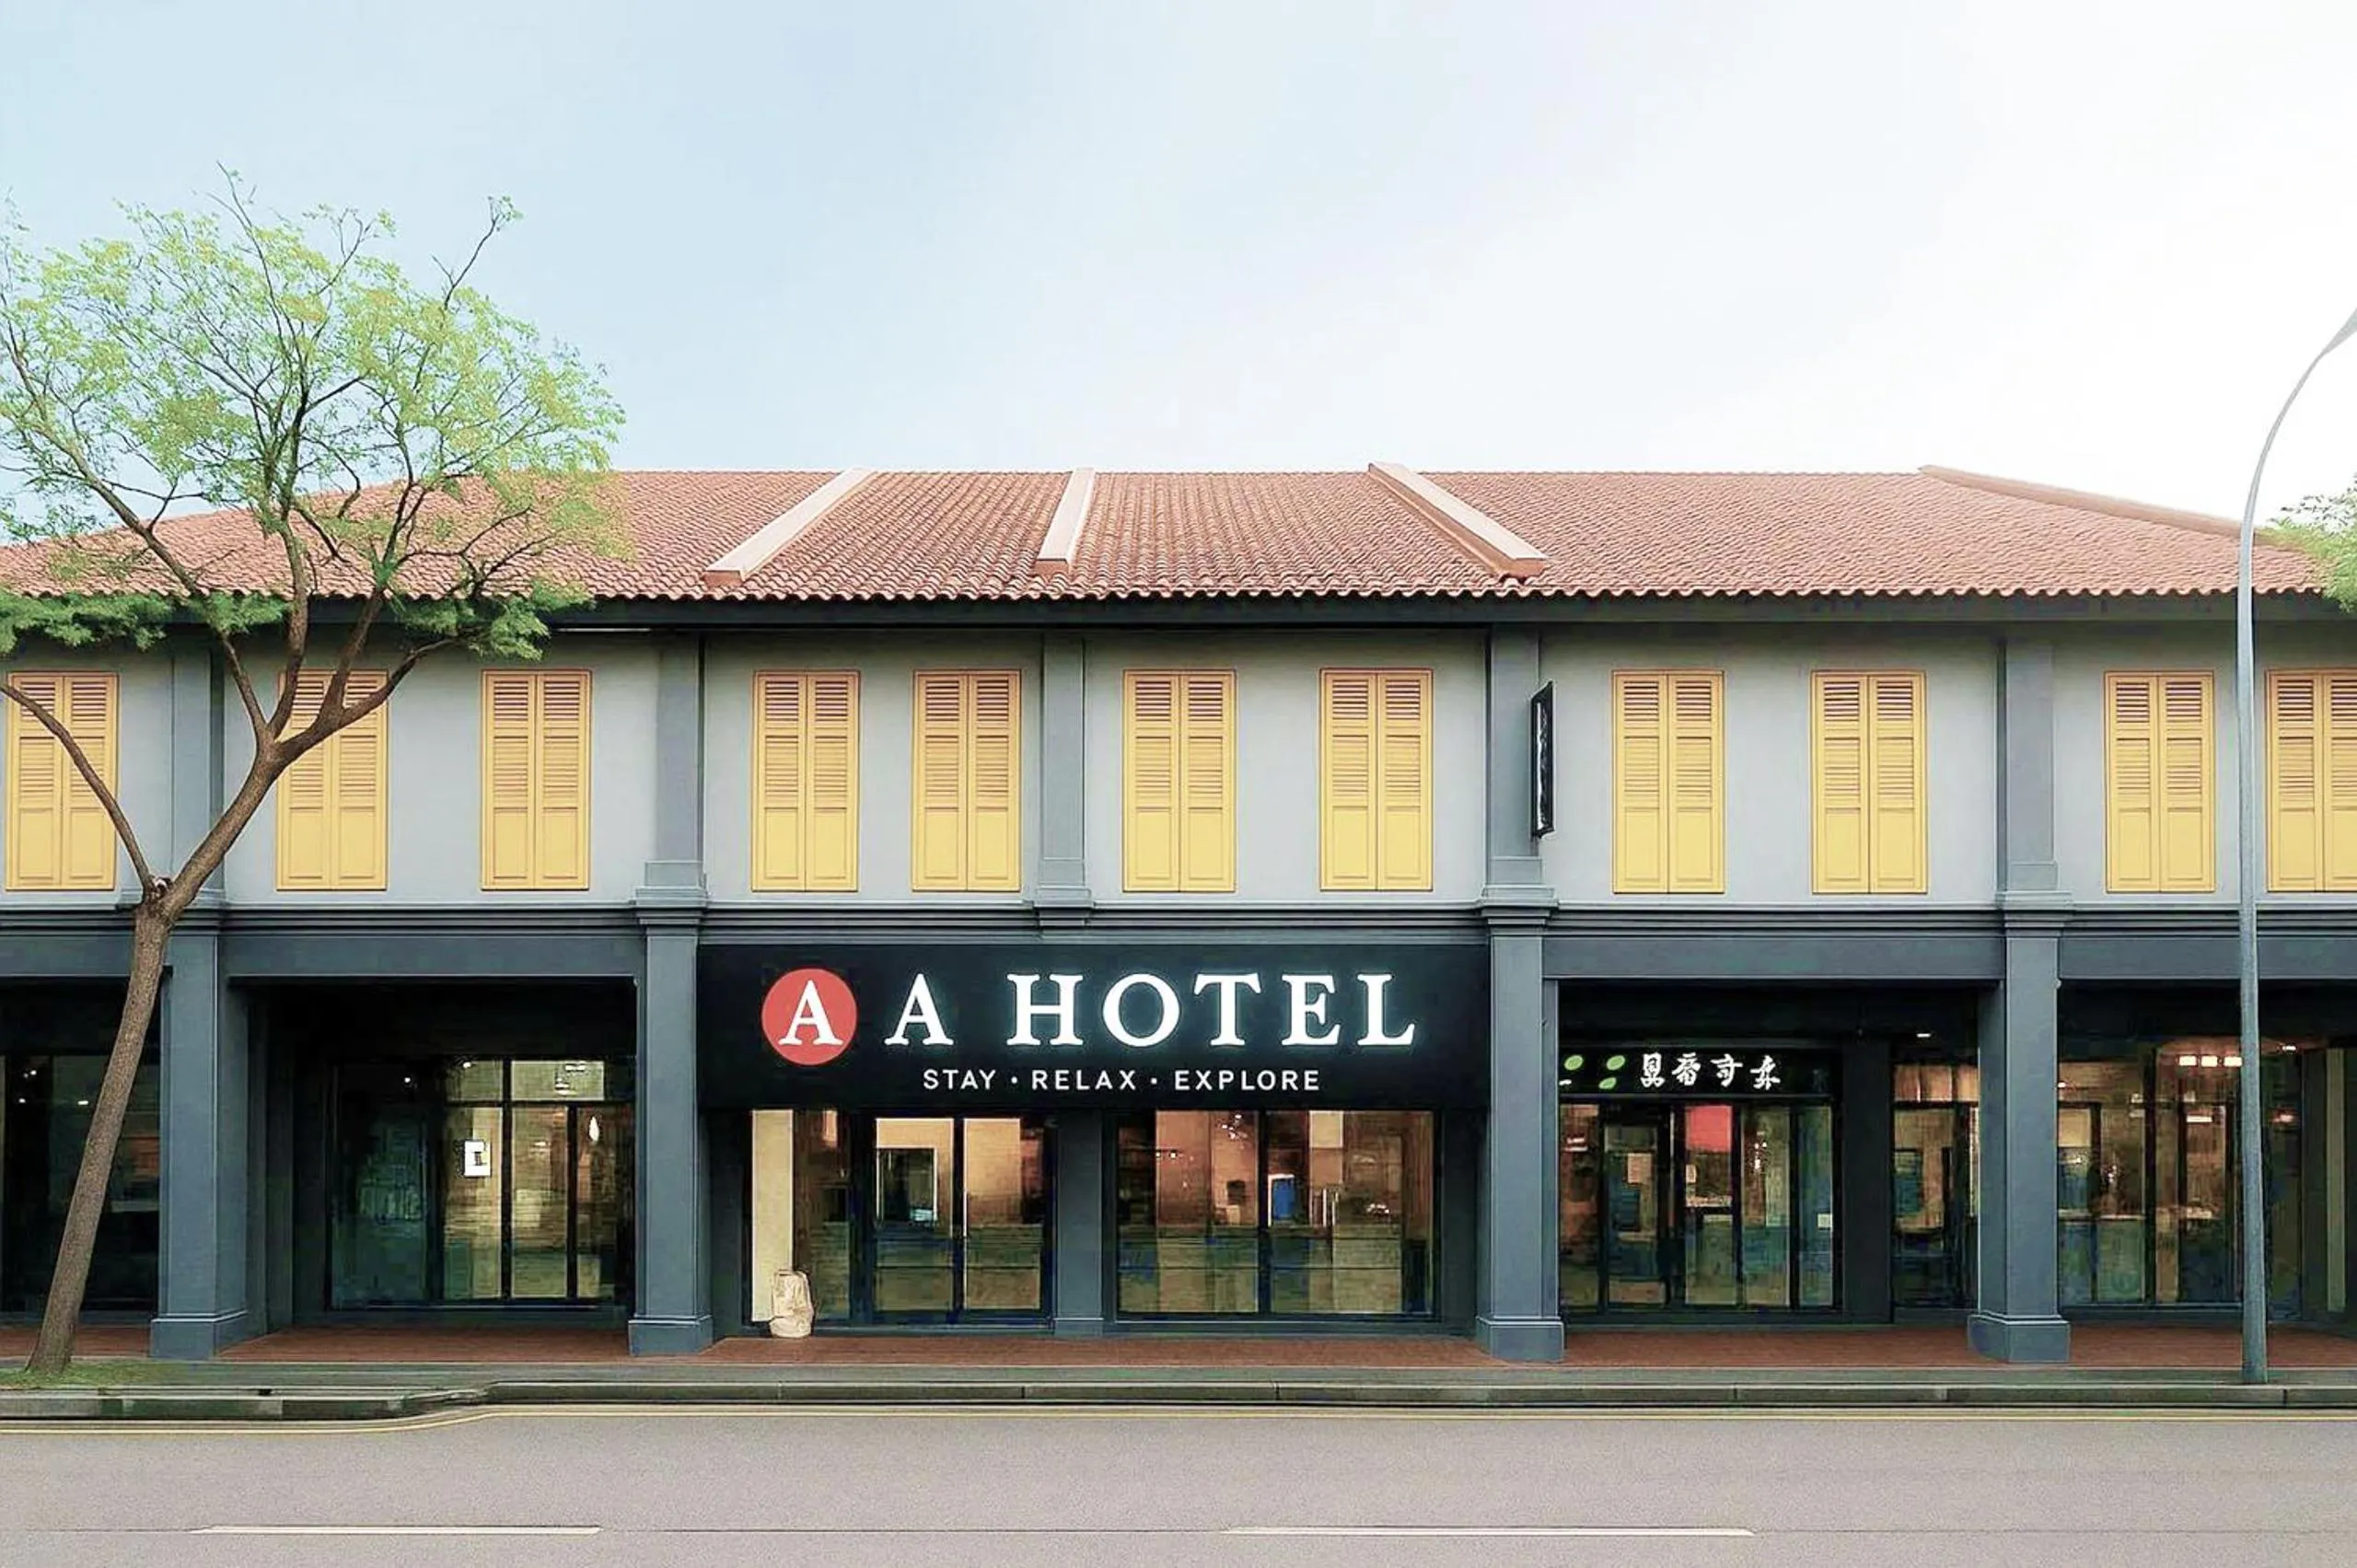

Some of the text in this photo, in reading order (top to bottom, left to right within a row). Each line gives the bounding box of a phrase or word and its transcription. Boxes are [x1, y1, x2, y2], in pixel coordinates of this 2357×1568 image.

[777, 979, 844, 1046] A
[884, 971, 1416, 1048] A HOTEL
[923, 1067, 1320, 1092] STAY RELAX EXPLORE
